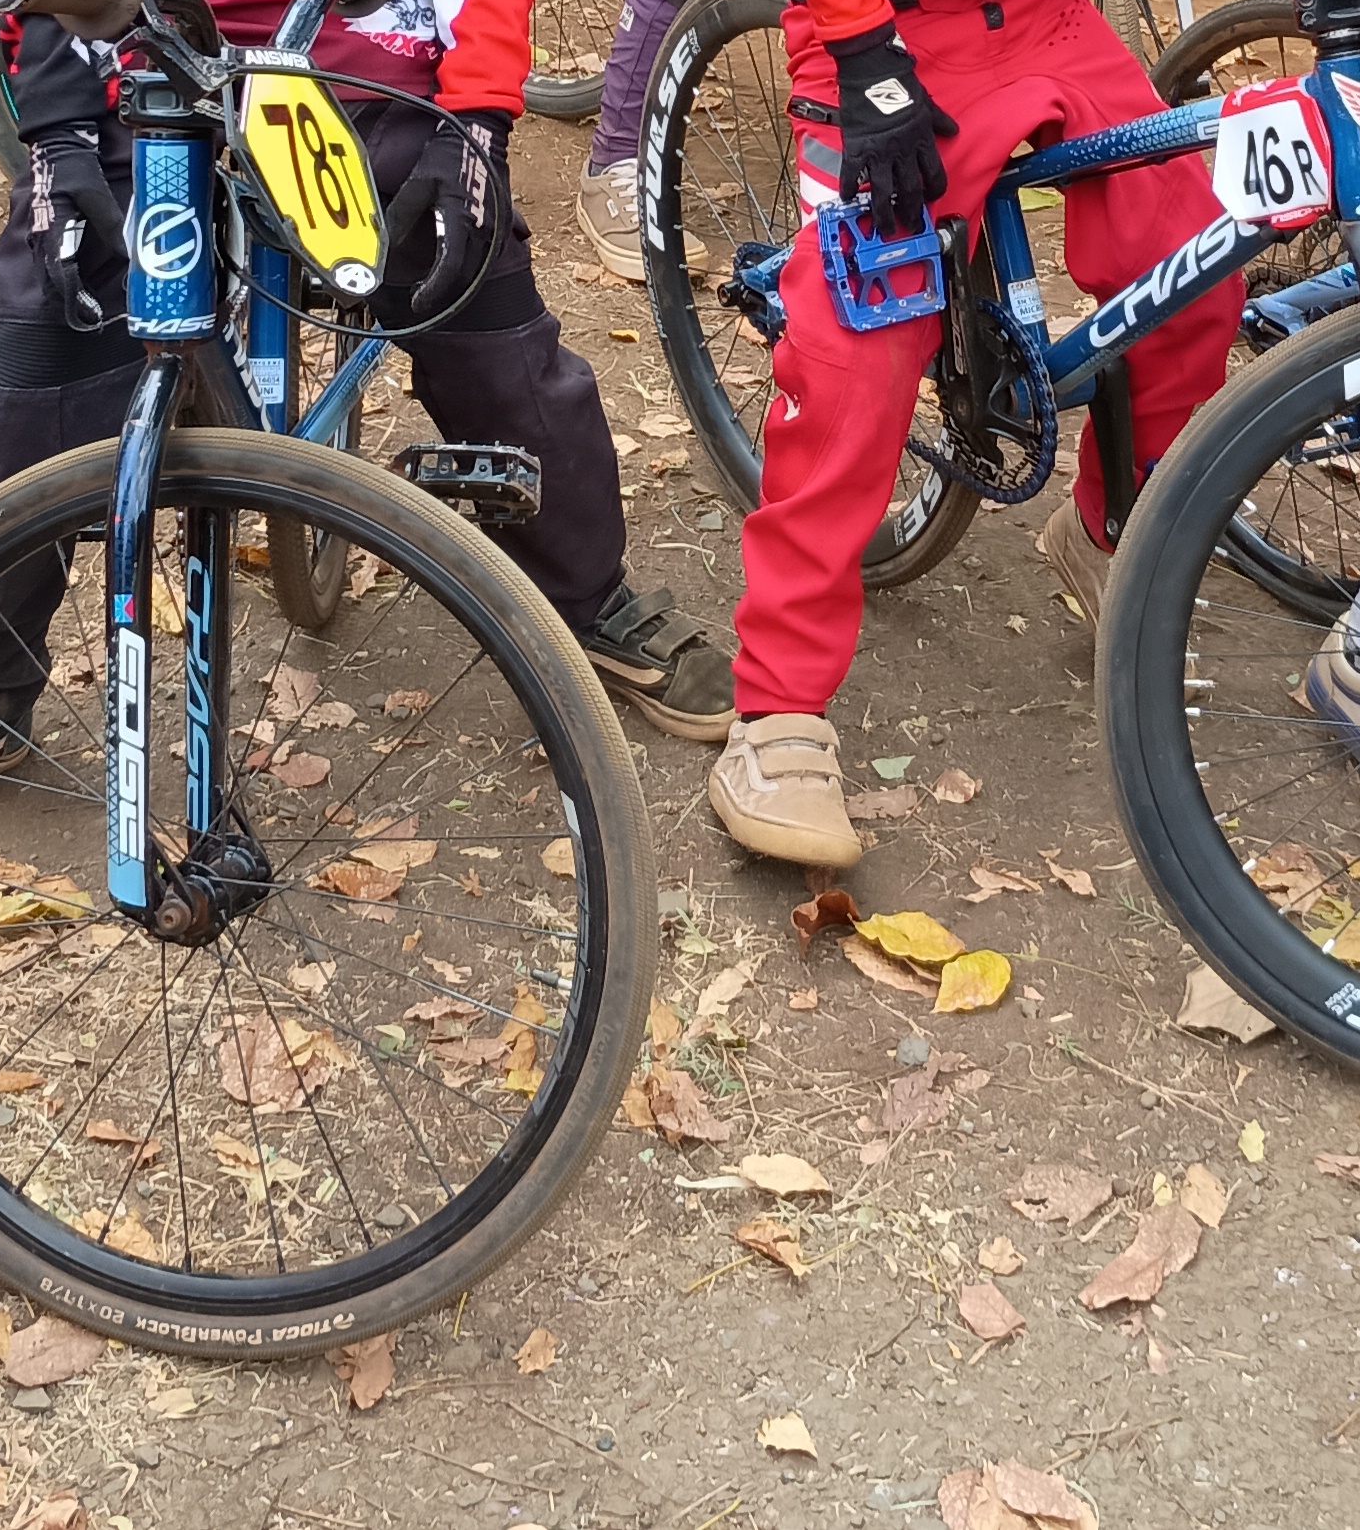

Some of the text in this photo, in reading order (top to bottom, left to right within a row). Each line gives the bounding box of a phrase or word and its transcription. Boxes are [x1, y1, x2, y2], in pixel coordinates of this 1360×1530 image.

[647, 33, 694, 252] PULSE
[118, 627, 146, 862] EDGE
[185, 555, 213, 834] CHASE
[272, 1318, 336, 1342] TIOGA
